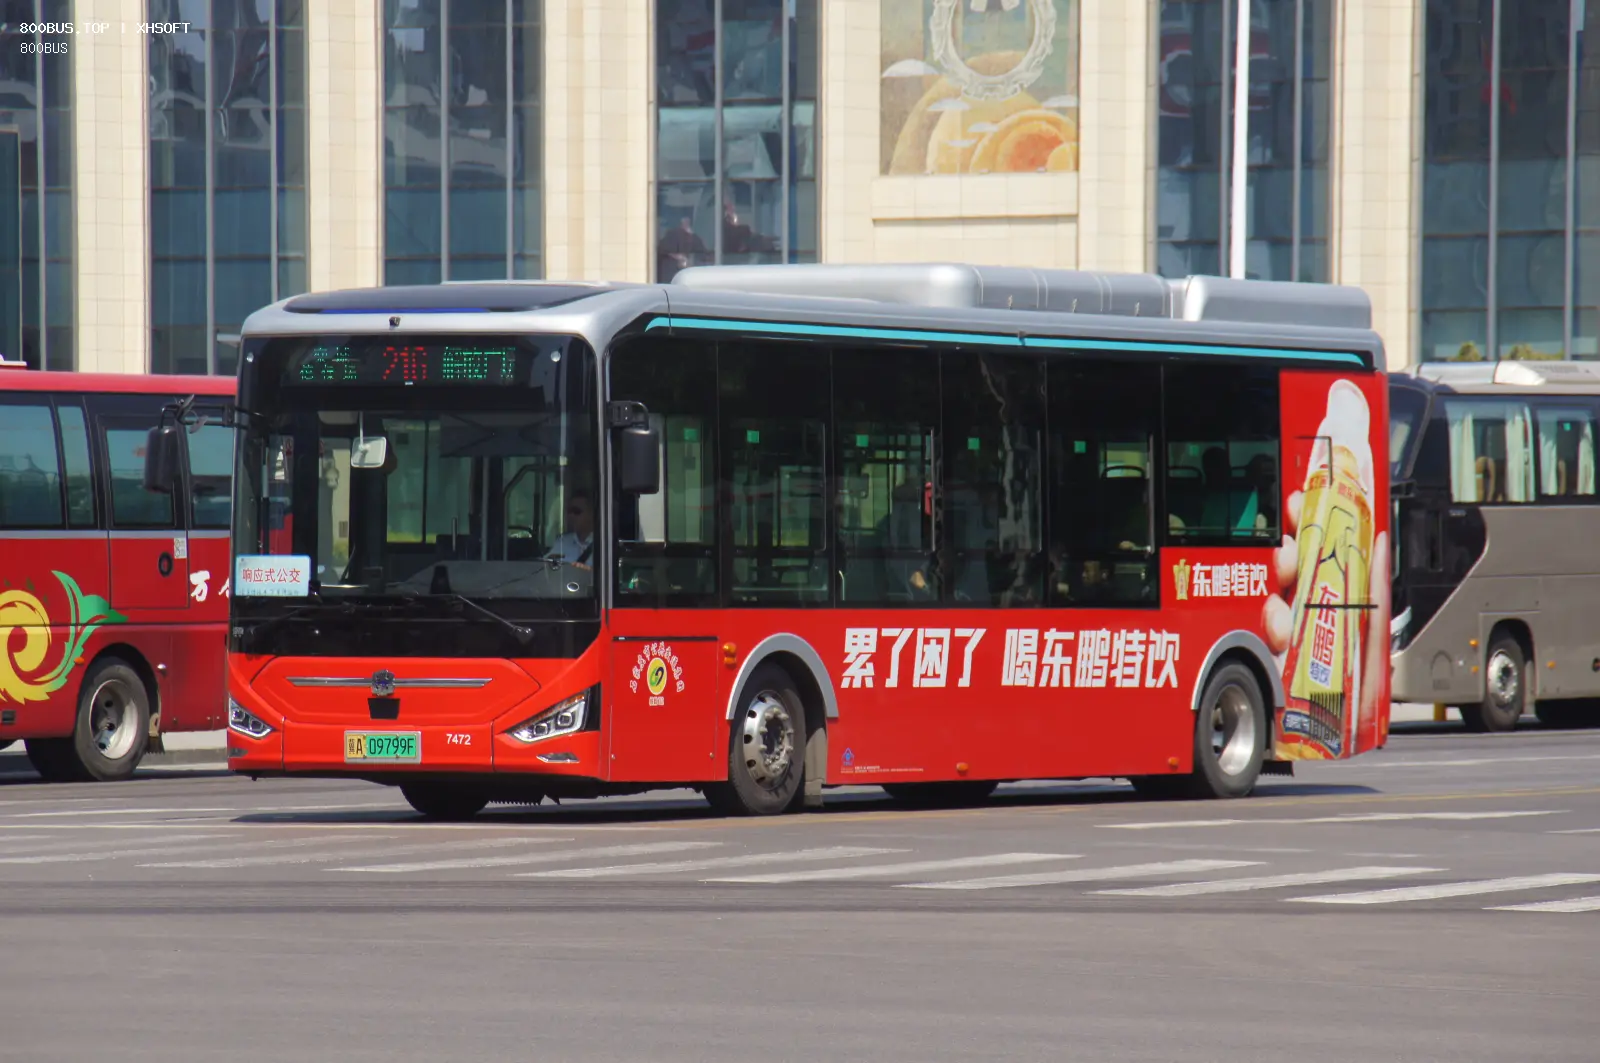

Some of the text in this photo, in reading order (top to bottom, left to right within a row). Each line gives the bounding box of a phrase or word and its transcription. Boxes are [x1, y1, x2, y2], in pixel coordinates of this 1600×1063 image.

[242, 567, 301, 584] 响应式公交
[1192, 562, 1269, 597] 东鹏特饮
[1312, 584, 1341, 668] 东鹏
[840, 627, 1181, 689] 累了困了 喝东鹏特饮
[369, 737, 415, 755] 09799F
[446, 733, 471, 746] 7472
